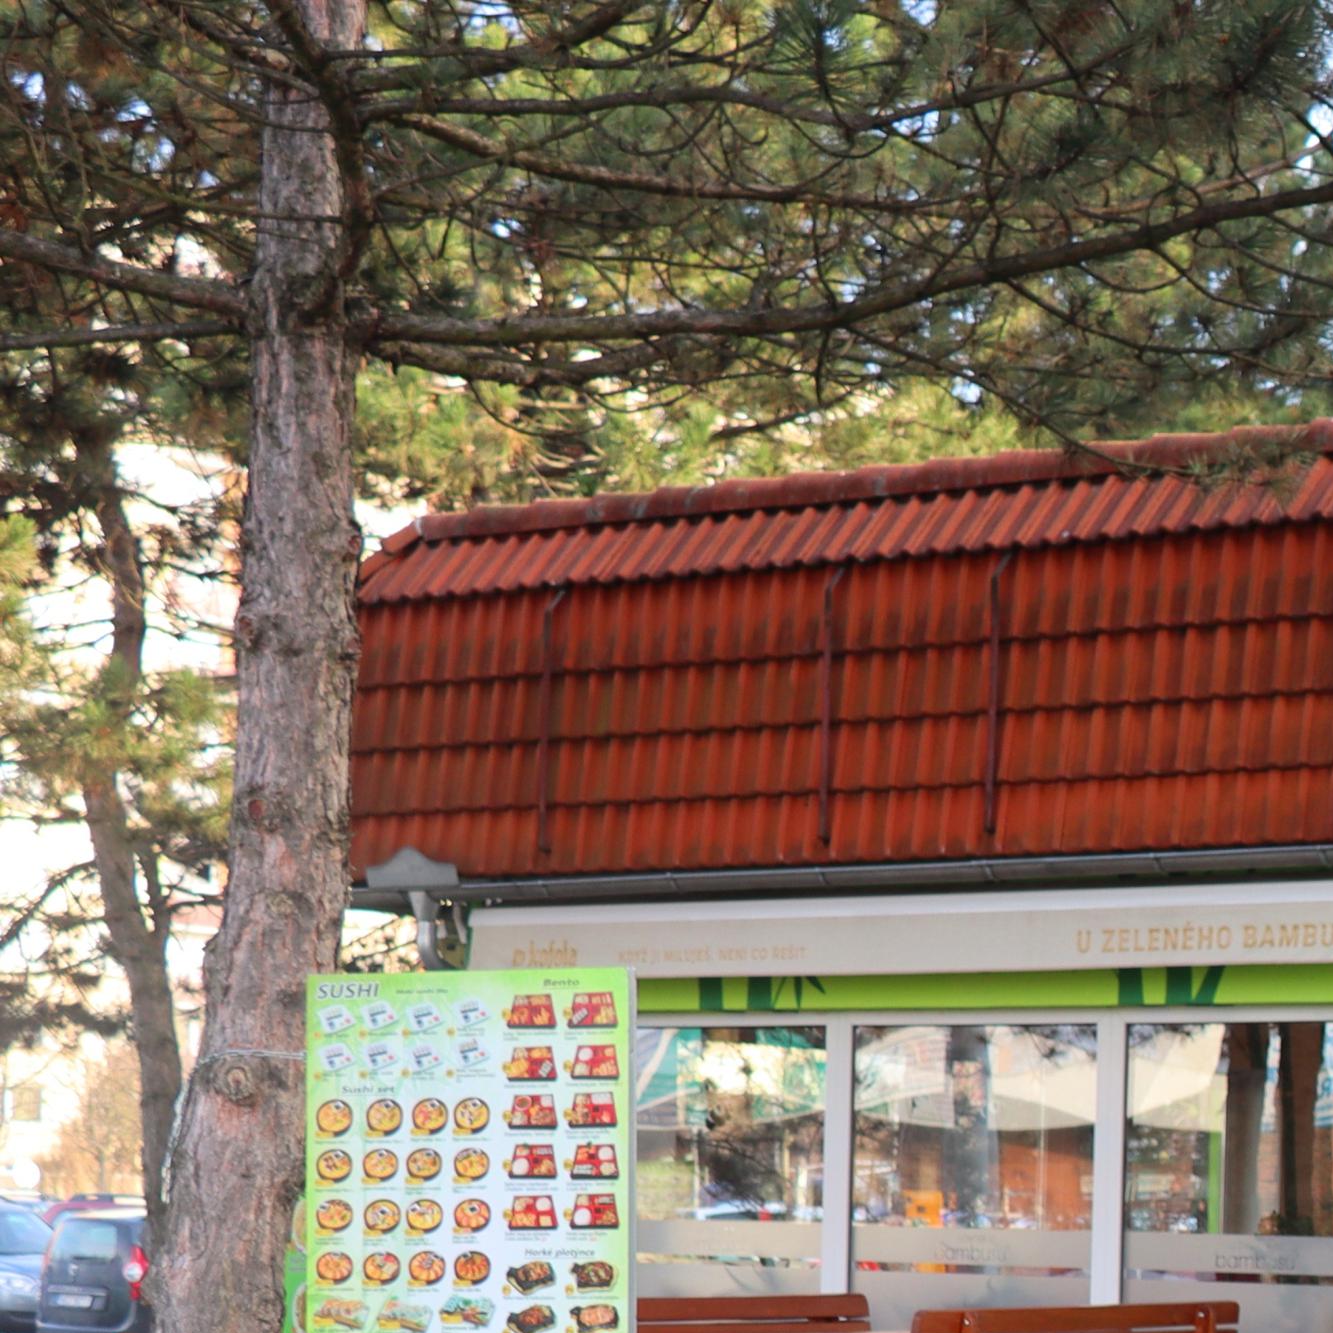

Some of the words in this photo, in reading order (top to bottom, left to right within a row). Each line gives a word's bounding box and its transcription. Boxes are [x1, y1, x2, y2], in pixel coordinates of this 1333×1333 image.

[1076, 929, 1092, 953] U
[1101, 921, 1232, 953] ZELENÉHO
[543, 978, 580, 987] Bento
[317, 983, 380, 999] SUSHI
[342, 1085, 373, 1094] Sushi
[377, 1086, 395, 1094] set
